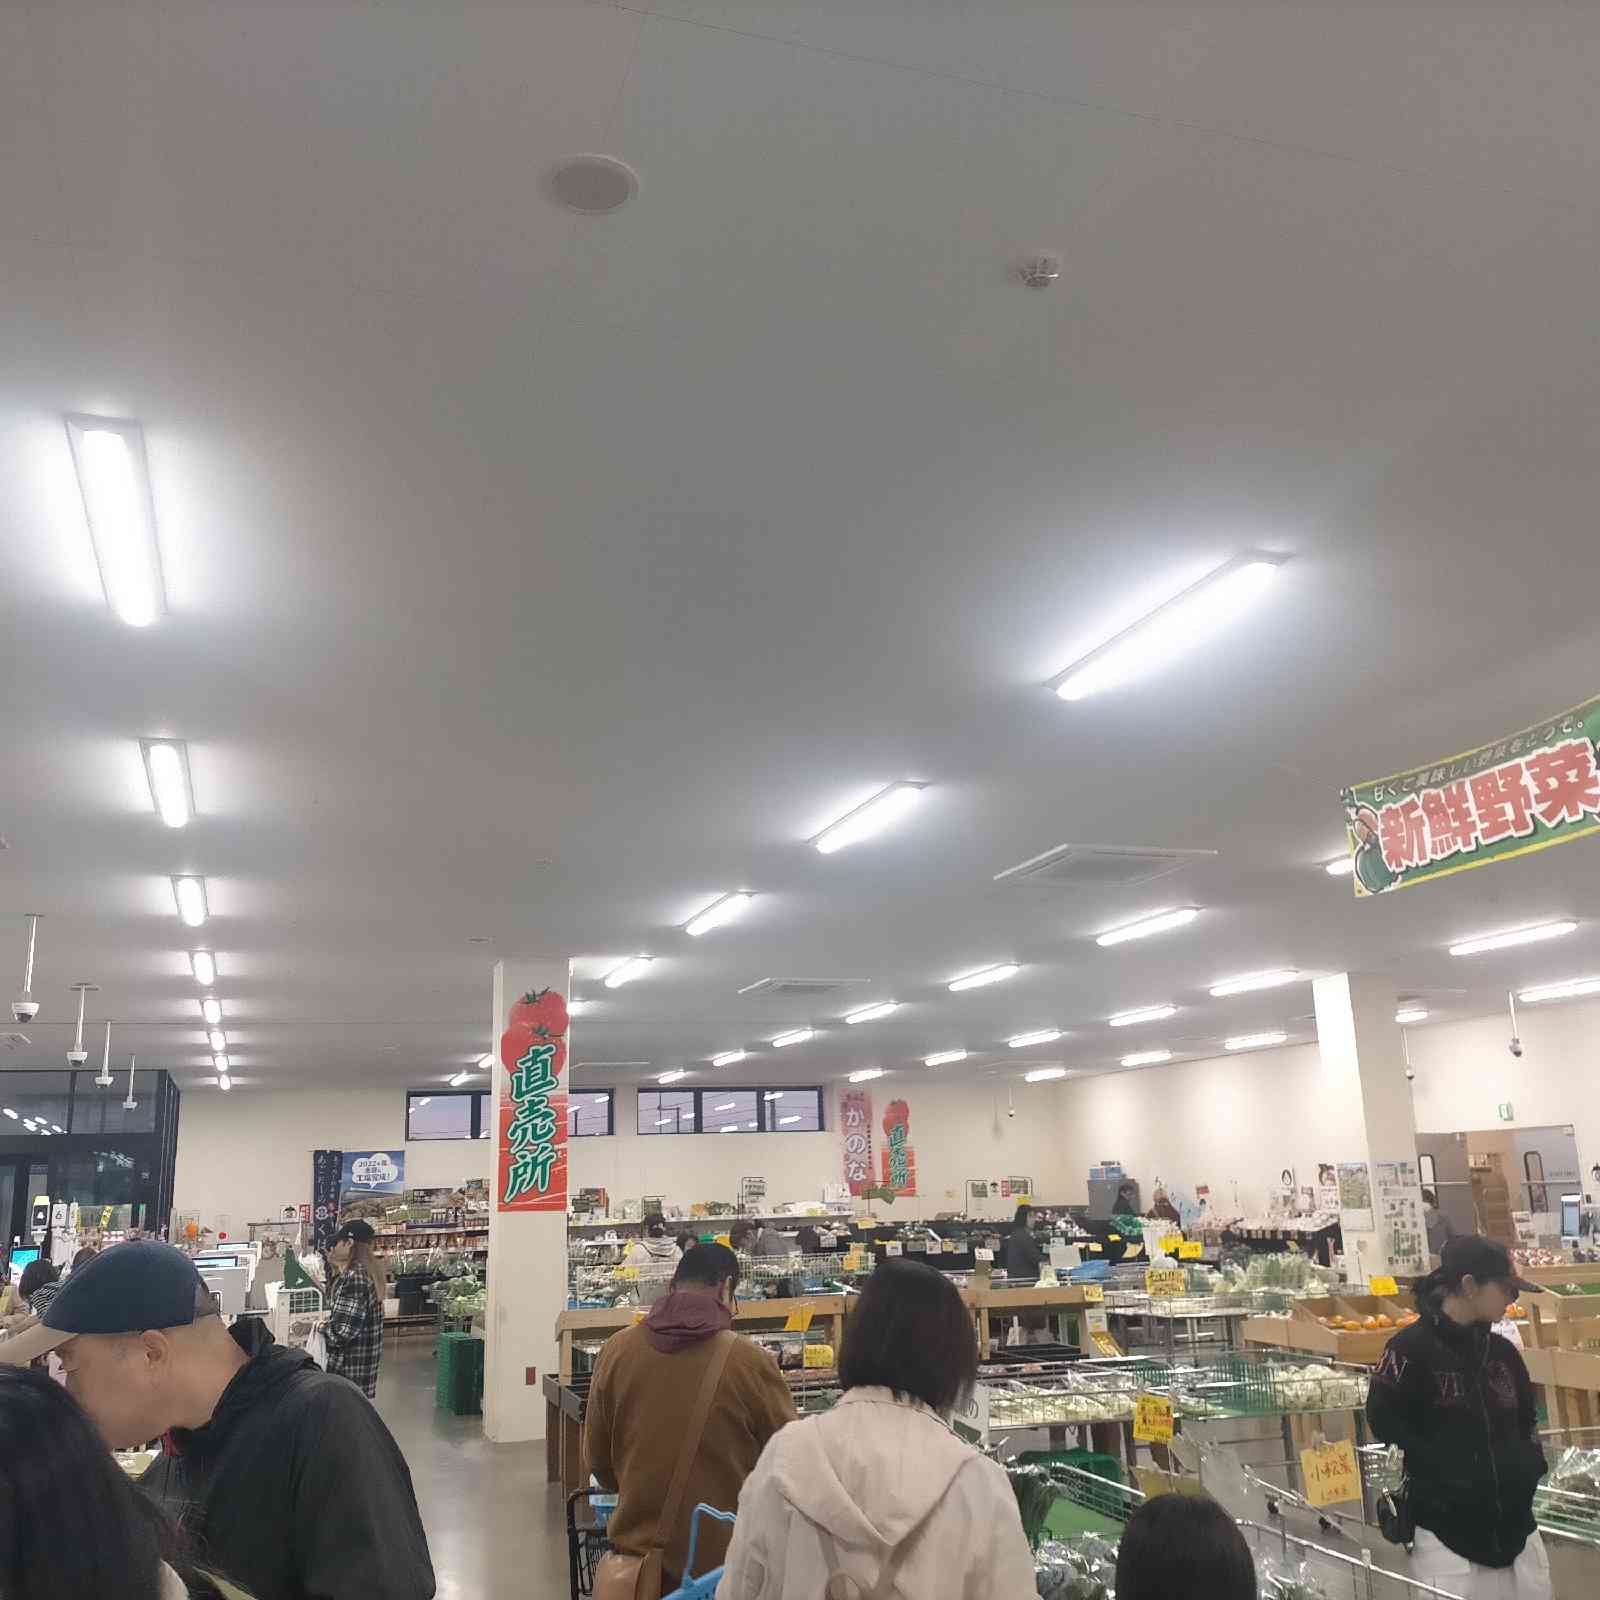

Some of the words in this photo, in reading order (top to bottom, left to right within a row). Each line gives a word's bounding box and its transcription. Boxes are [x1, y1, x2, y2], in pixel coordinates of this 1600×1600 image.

[1379, 738, 1600, 872] 新鮮野菜
[505, 1045, 558, 1203] 直売所
